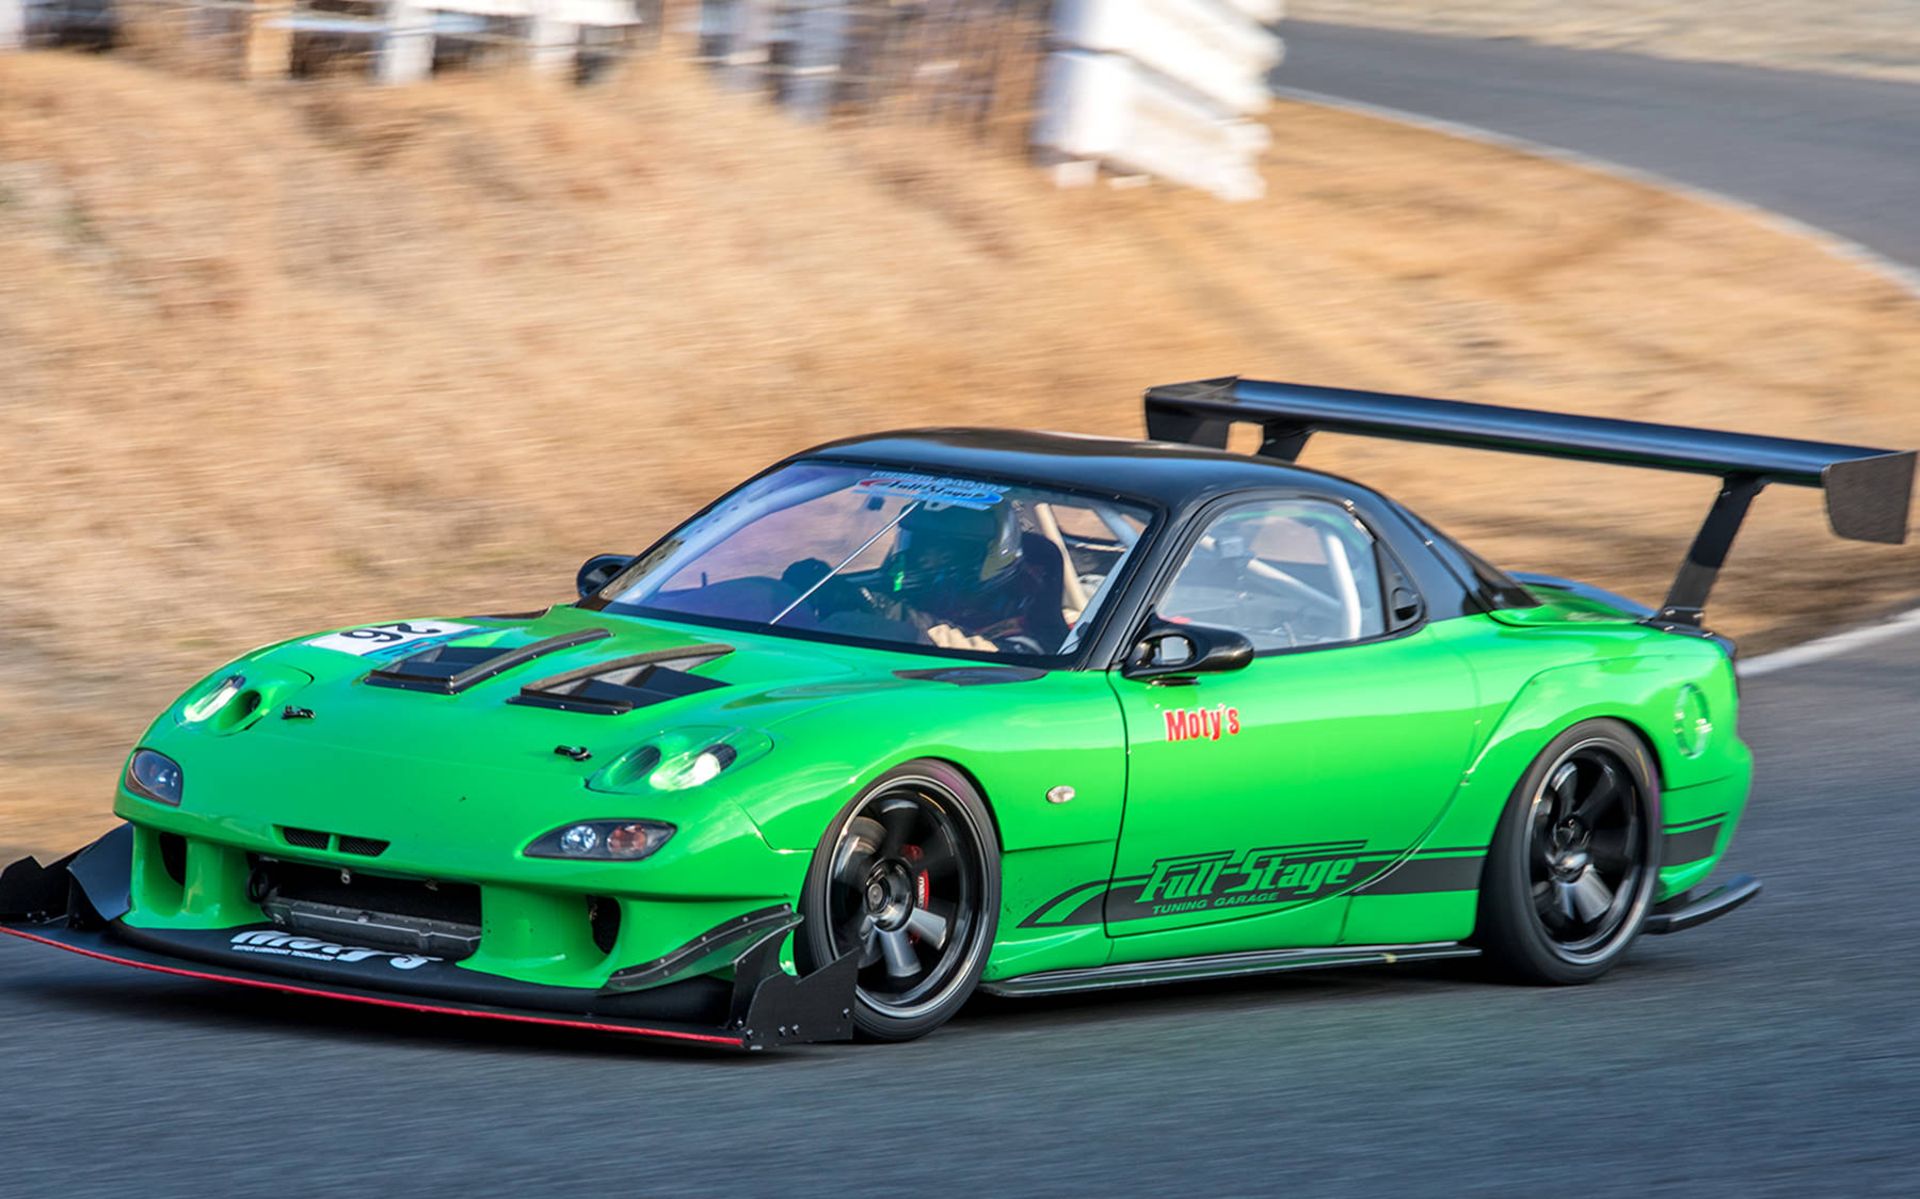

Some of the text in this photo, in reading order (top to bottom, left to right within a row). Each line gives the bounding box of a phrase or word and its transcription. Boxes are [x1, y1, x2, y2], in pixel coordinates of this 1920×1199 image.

[1163, 704, 1241, 742] Moty's
[1134, 843, 1362, 903] Full Stage
[1152, 891, 1279, 915] TUNING GARAGE
